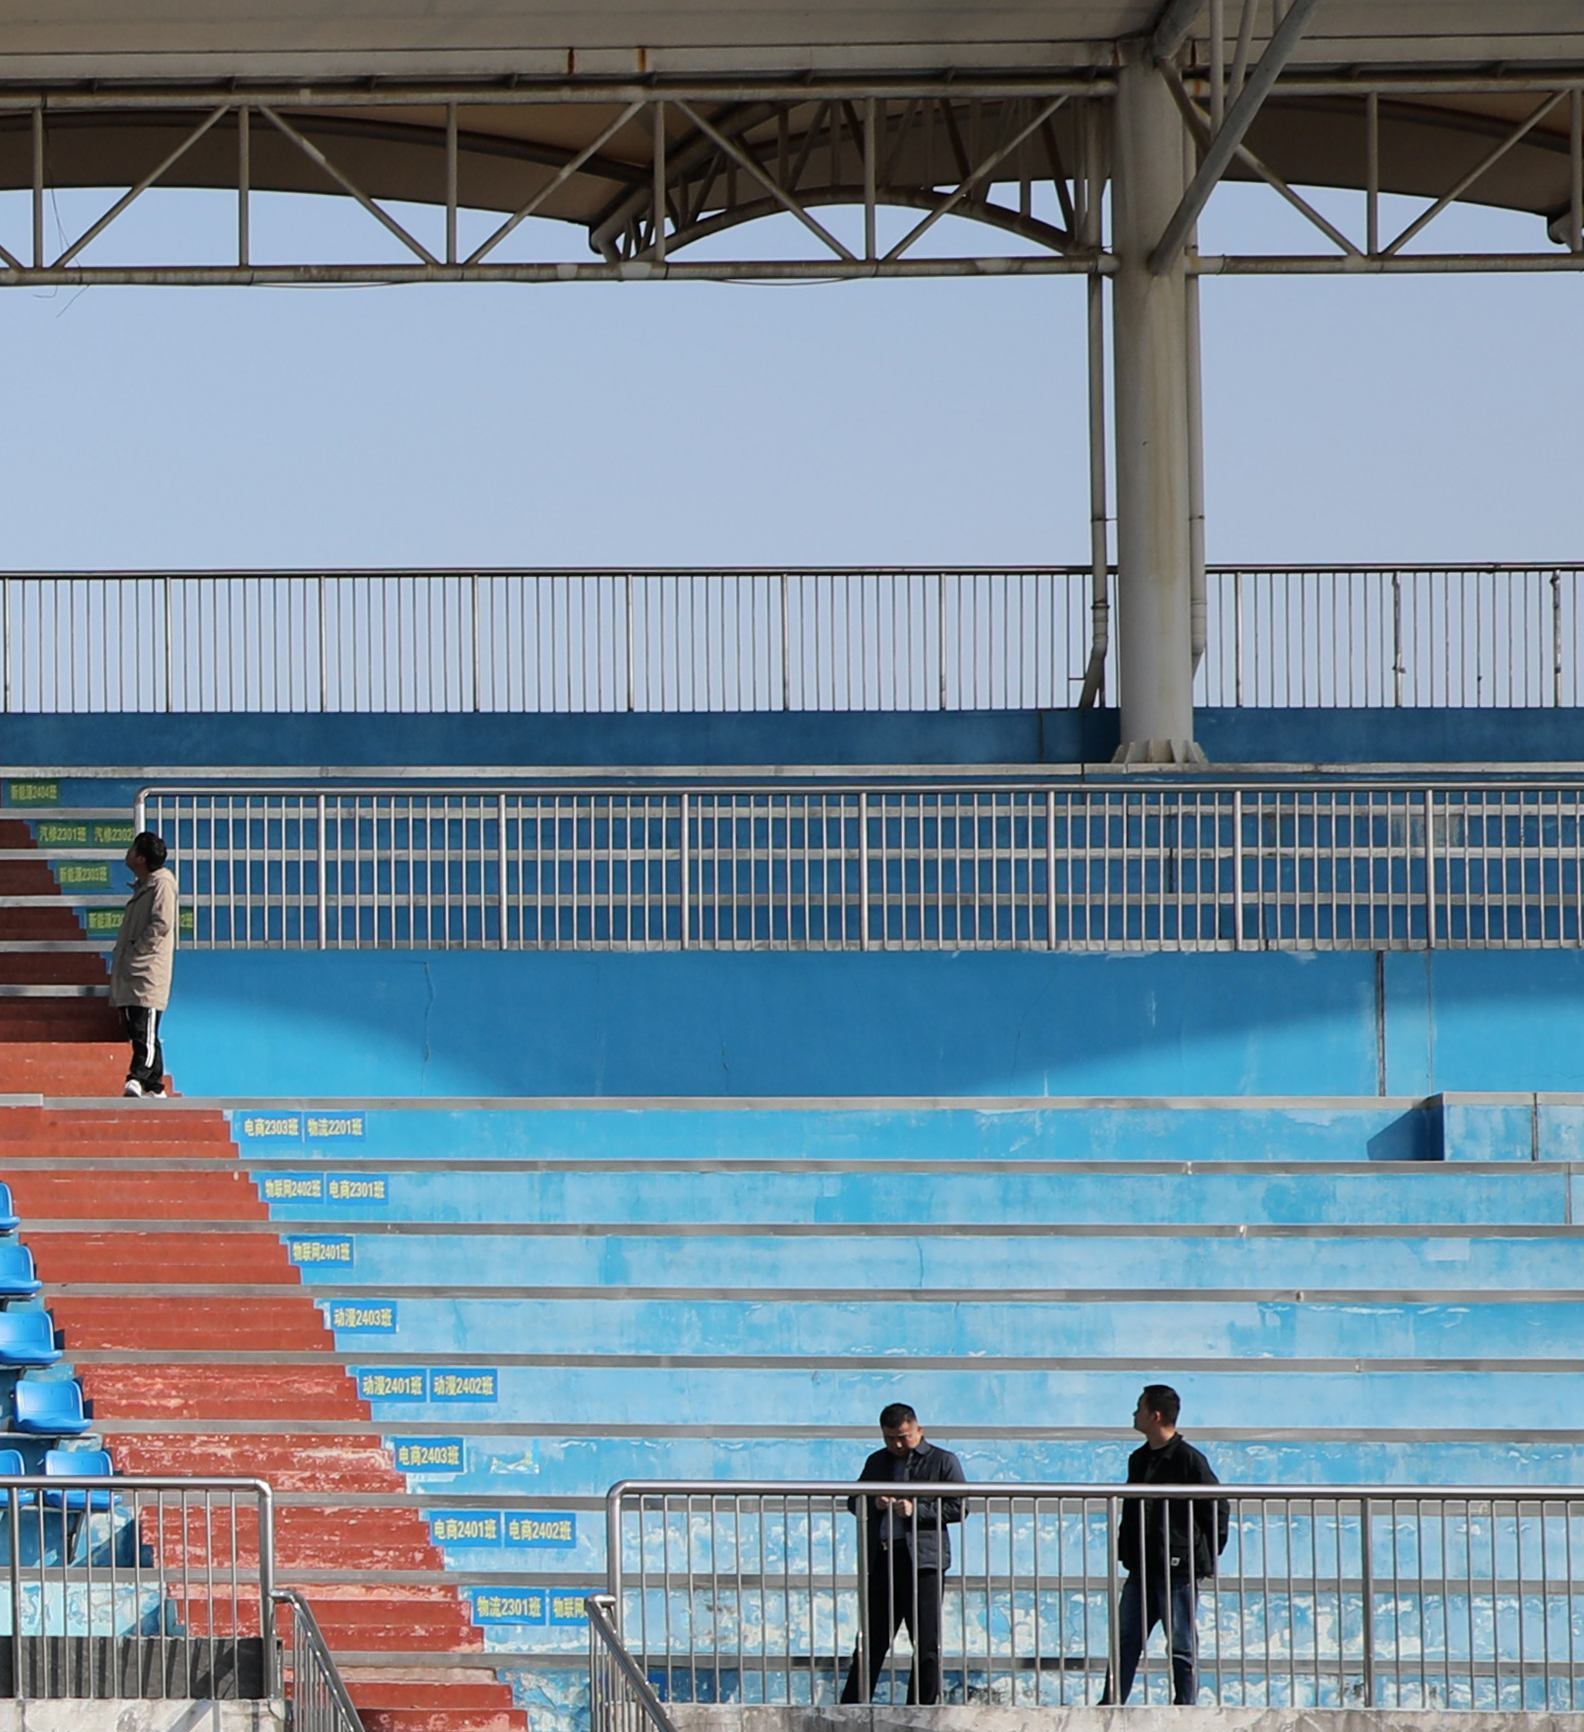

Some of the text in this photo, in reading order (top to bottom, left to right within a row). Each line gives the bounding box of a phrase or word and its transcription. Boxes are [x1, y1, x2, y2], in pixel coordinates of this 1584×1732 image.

[94, 826, 136, 843] 汽修2302
[245, 1118, 299, 1137] 电商2303班
[307, 1118, 363, 1137] 物流2201班
[265, 1179, 322, 1198] 物联网2402班
[329, 1180, 385, 1199] 电商2301班
[293, 1242, 350, 1262] 物联网2401班
[334, 1308, 392, 1328] 动漫2403班
[363, 1375, 423, 1395] 动漫2401班
[434, 1375, 494, 1395] 动漫2402班
[399, 1445, 460, 1466] 电商2403班
[434, 1518, 497, 1540] 电商2401班
[509, 1519, 571, 1541] 电商2402班
[477, 1596, 542, 1618] 物流2301班
